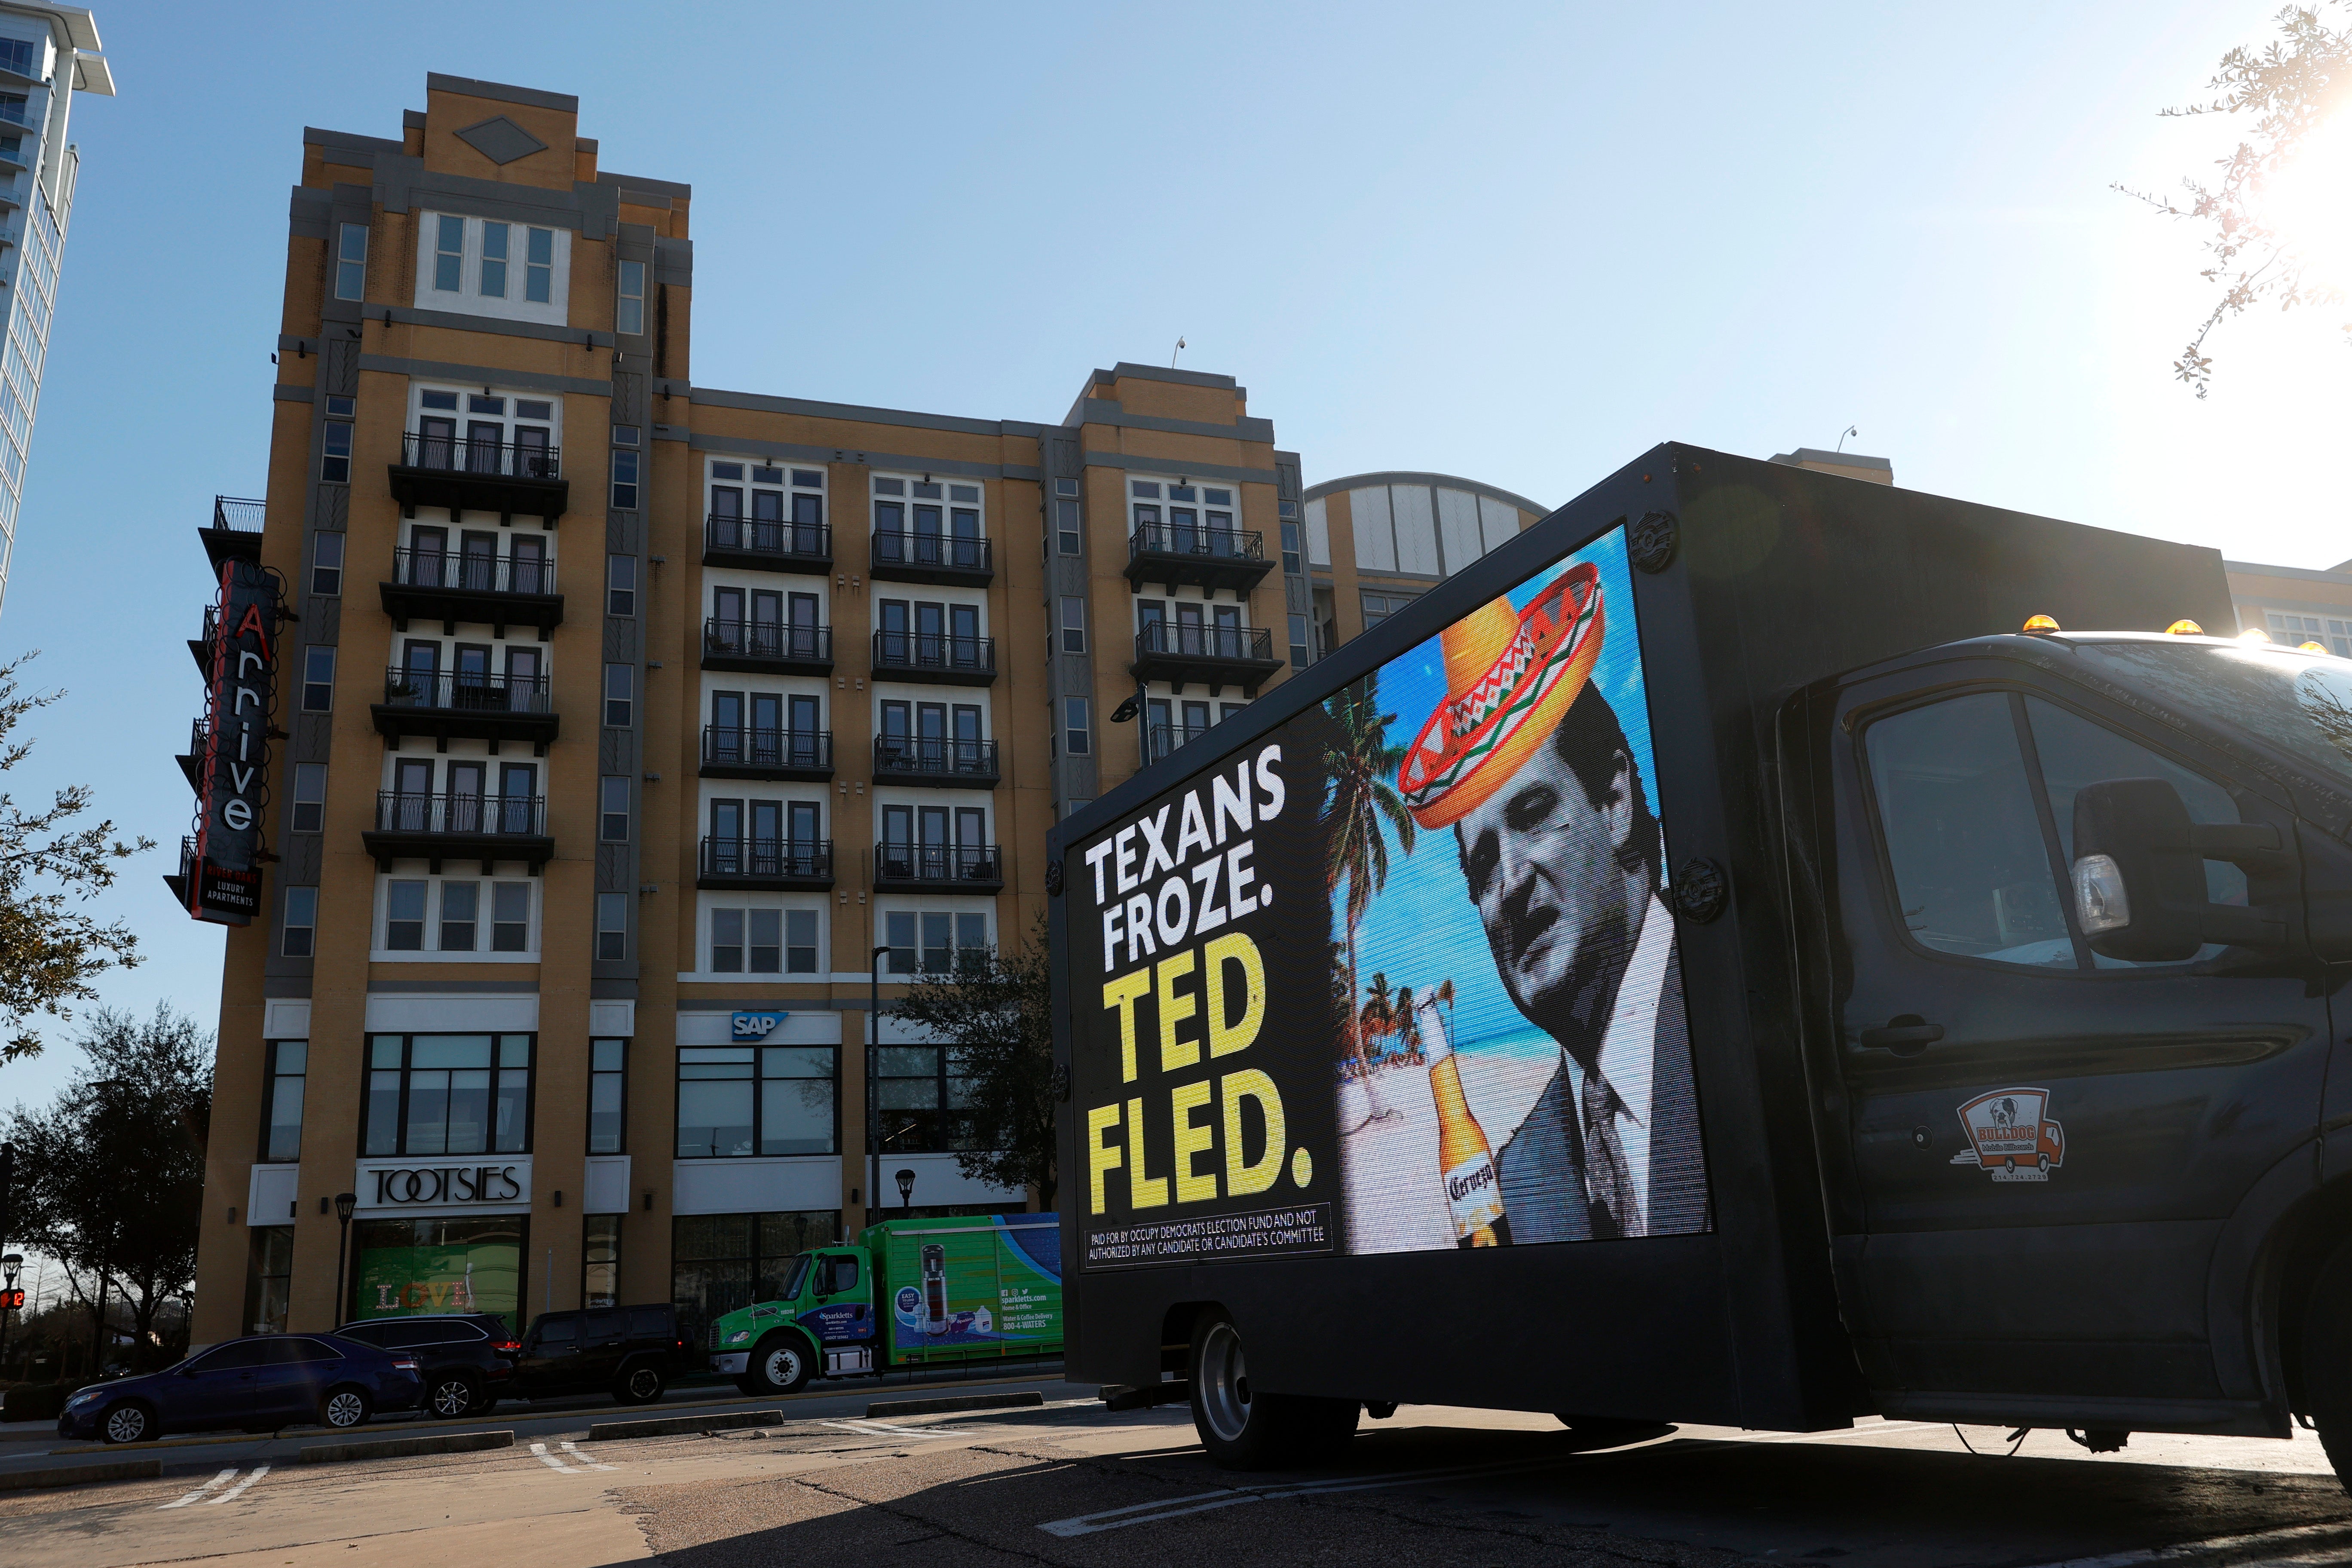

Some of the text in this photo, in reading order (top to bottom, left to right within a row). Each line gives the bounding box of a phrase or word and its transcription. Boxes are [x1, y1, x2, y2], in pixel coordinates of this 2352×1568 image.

[224, 603, 270, 831] Arrive
[1085, 744, 1286, 905] TEXANS
[207, 865, 257, 884] RIVER OAKS
[217, 881, 245, 894] LUXURY
[207, 890, 253, 906] APARTMENTS
[1103, 839, 1273, 972] FROZE.
[1103, 932, 1266, 1083] TED
[733, 1016, 776, 1035] SAP
[1088, 1068, 1312, 1215] FLED.
[1978, 1126, 2036, 1141] BULLDOG
[1982, 1143, 2003, 1151] Mobile
[368, 1166, 520, 1204] TOOTSIES
[1091, 1209, 1317, 1245] PAID FOR BY OCCUPY DEMOCRATS ELECTION FUND AND NOT
[1089, 1226, 1324, 1260] AUTHORIZED BY ANY CANDIDATE OR CANDIDATE'S COMMITTEE
[14, 1293, 23, 1305] 12
[1001, 1295, 1046, 1304] sparkletts.com
[823, 1312, 853, 1320] Sparkletts
[1003, 1320, 1046, 1330] 800-4-WATERS
